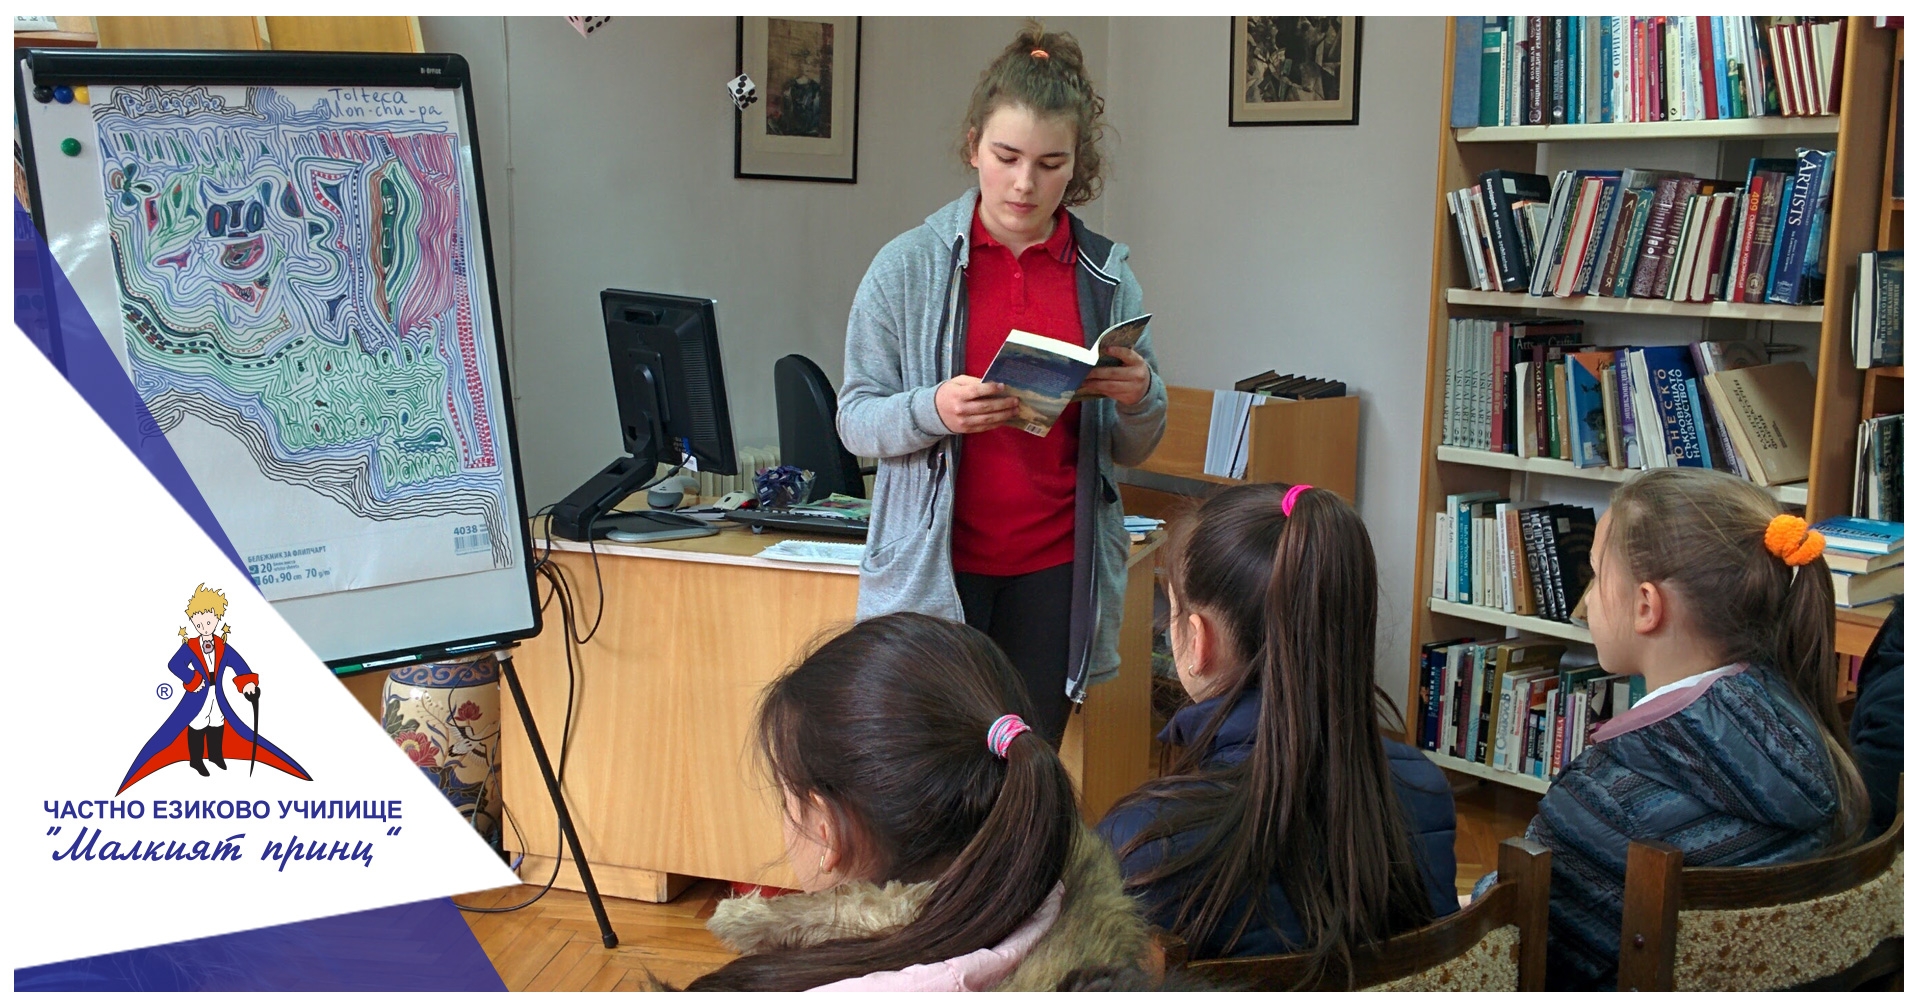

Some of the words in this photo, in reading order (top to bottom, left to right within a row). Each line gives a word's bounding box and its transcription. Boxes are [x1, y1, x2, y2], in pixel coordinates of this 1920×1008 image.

[1612, 16, 1621, 66] ОРИГАМ
[1749, 191, 1760, 212] 409
[1788, 158, 1817, 226] ARTISTS
[1486, 178, 1498, 210] Encyclopedia
[1498, 241, 1509, 273] architecture
[1587, 185, 1615, 265] ARCHITECTS
[1744, 214, 1756, 252] СЪВРЕМЕННИ
[1880, 272, 1888, 344] ЕНЦИКЛОПЕДИЯ
[1657, 368, 1684, 460] ЮНЕСКО
[1668, 368, 1694, 459] СЪКРОВИЩАТА
[1676, 368, 1696, 440] ИЗКУСТВОТО
[1733, 378, 1773, 449] АРХИТЕКТУРНИ
[1733, 389, 1768, 450] КЛАСИЧЕСКИ
[1692, 443, 1700, 458] НА
[1758, 414, 1778, 449] ФОРМИ
[248, 552, 282, 562] БЕЛЕЖНИК
[283, 550, 292, 558] ЗА
[292, 546, 326, 556] ФЛИПЧАРТ
[454, 525, 478, 536] 4038
[260, 562, 272, 574] 20
[262, 574, 274, 585] 60
[280, 572, 292, 582] 90
[305, 568, 317, 578] 70
[1430, 666, 1436, 676] НА
[1554, 719, 1564, 765] ЕСТЕТИКА
